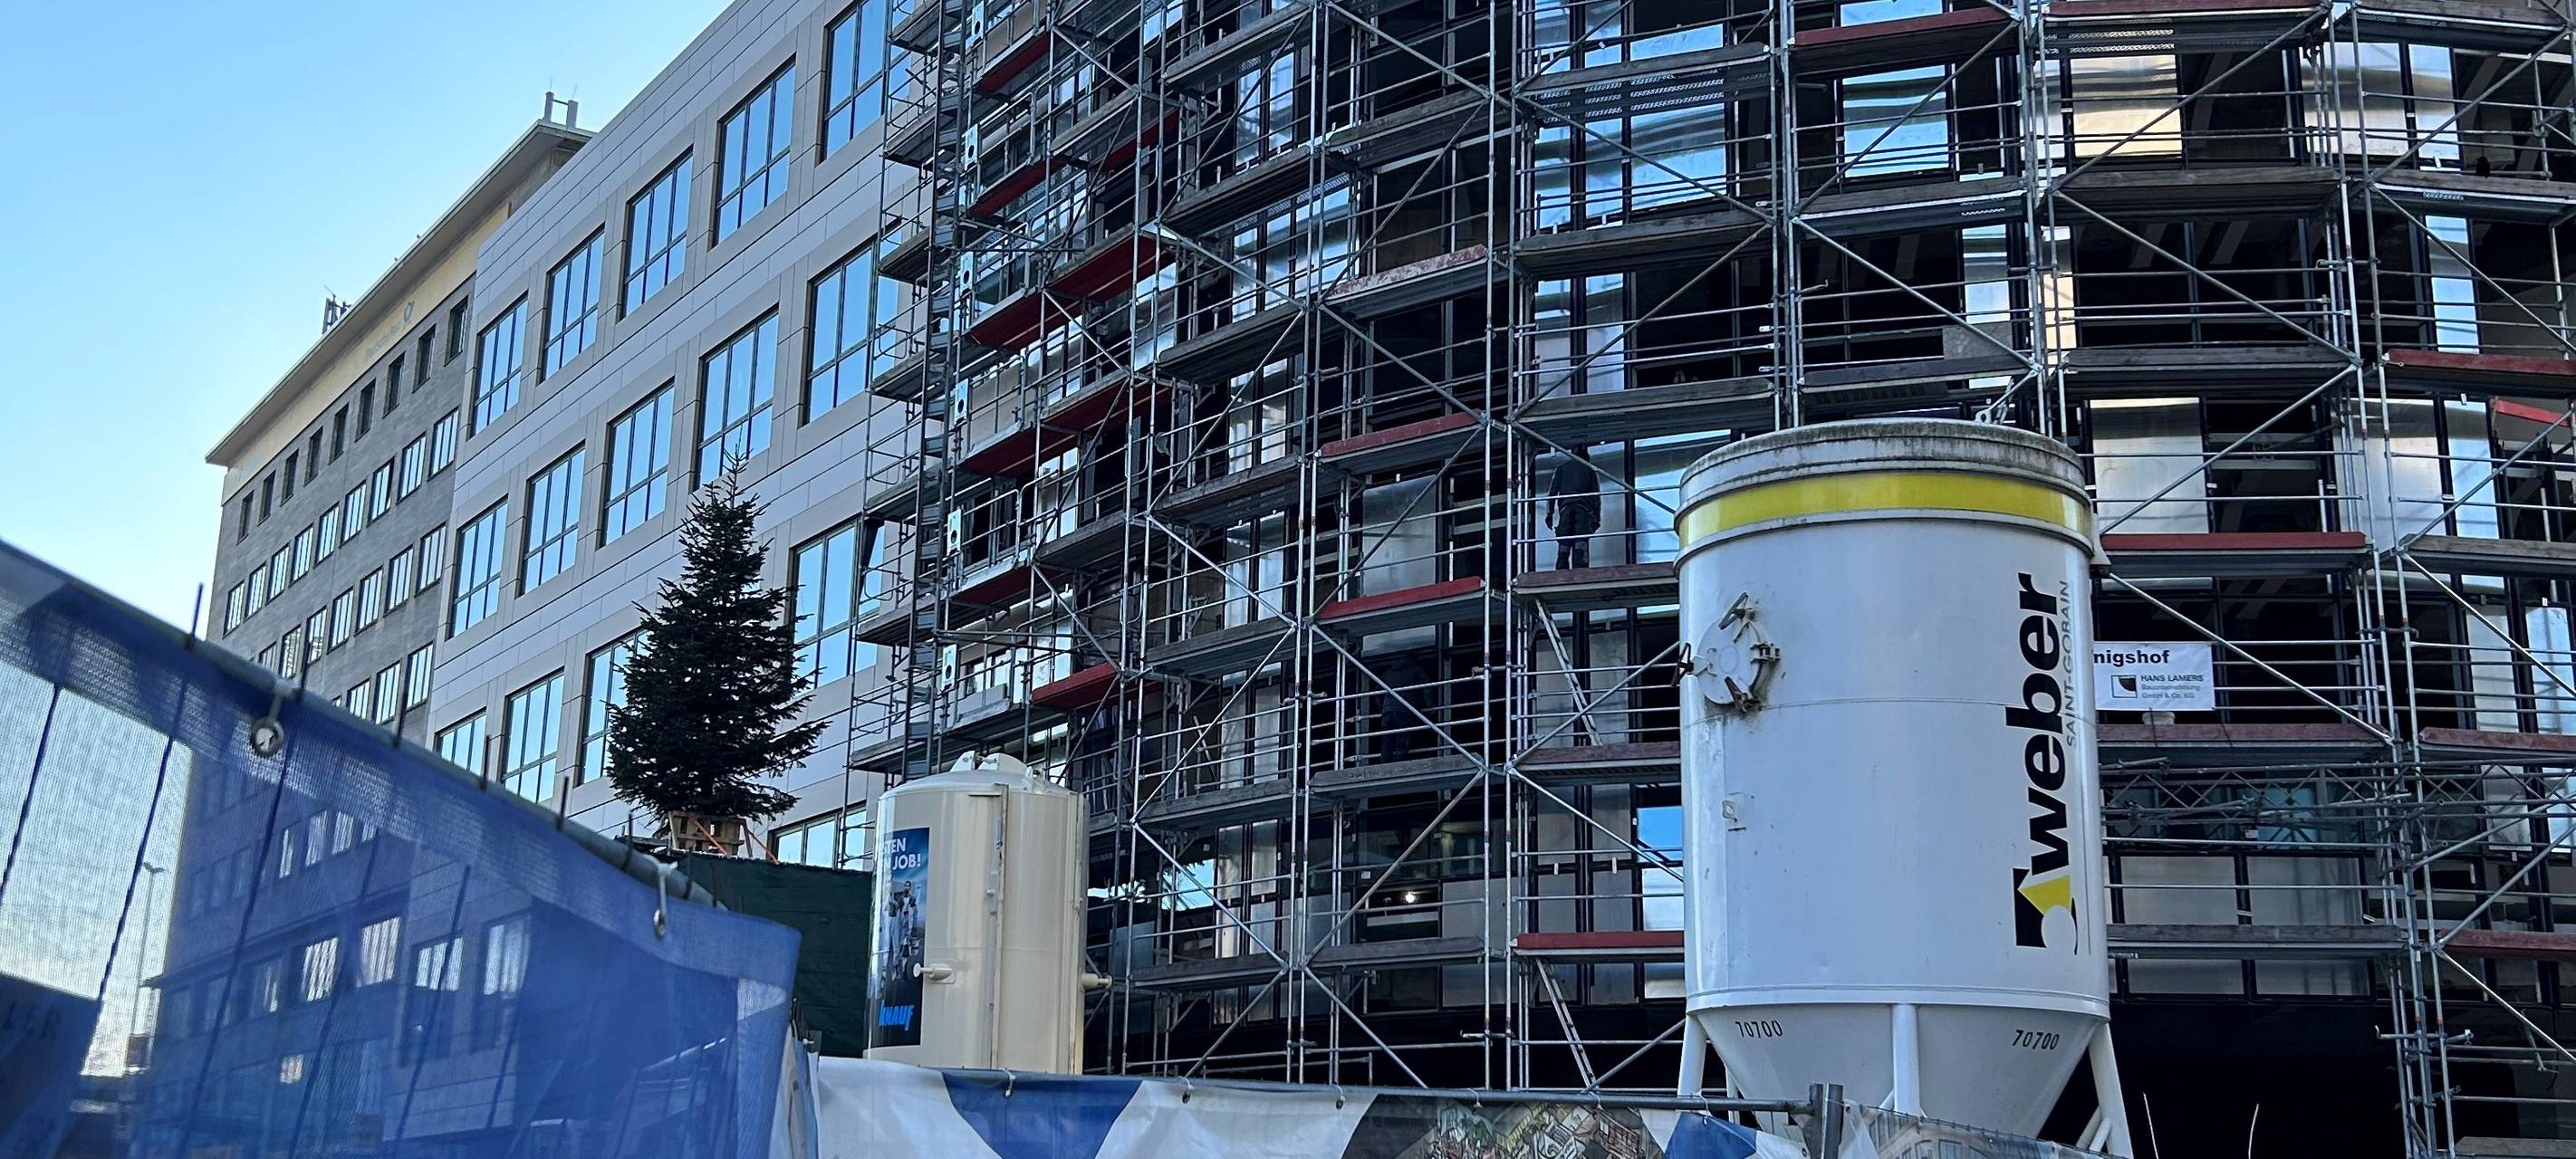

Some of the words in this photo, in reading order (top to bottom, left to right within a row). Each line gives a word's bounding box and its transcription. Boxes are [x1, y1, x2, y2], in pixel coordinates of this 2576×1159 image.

[2059, 580, 2078, 747] SAINT-GORAIN
[2093, 649, 2170, 667] nigshof
[2140, 674, 2166, 682] HANS
[2167, 674, 2204, 682] LAMERS
[2004, 572, 2070, 876] weber
[892, 853, 921, 870] JOB!
[1734, 1020, 1783, 1039] 70700
[2012, 1029, 2061, 1050] 70700
